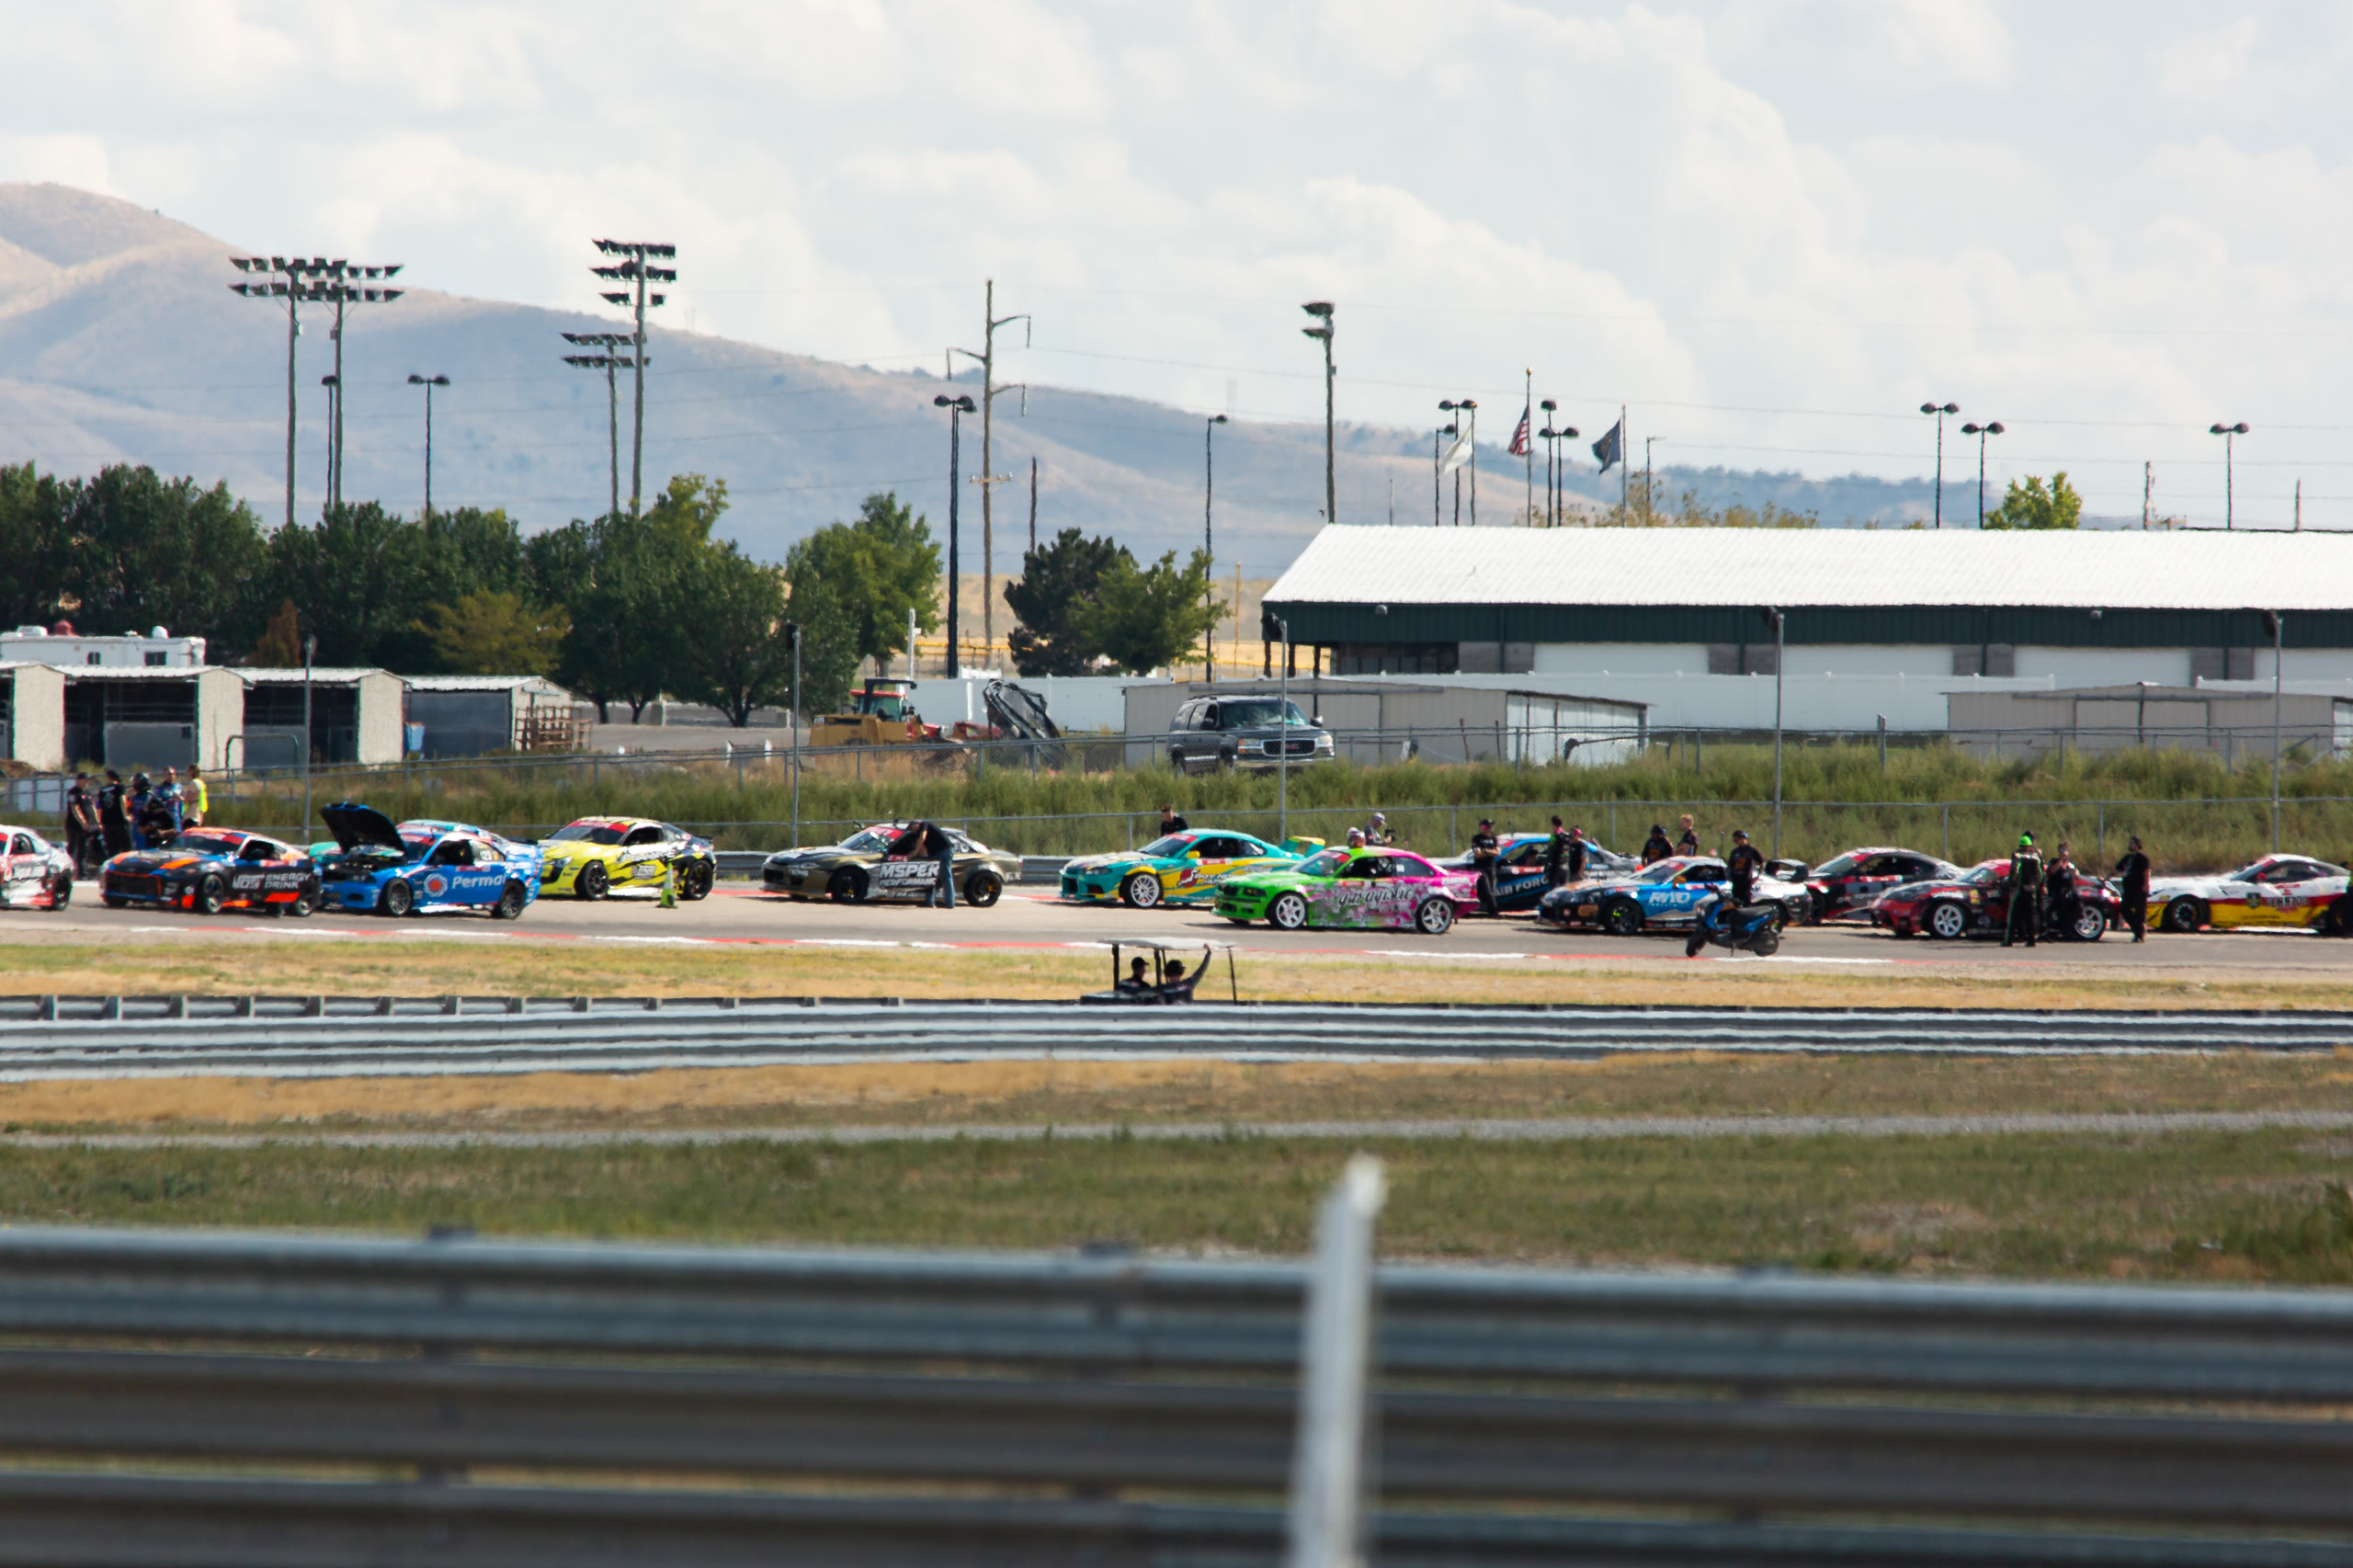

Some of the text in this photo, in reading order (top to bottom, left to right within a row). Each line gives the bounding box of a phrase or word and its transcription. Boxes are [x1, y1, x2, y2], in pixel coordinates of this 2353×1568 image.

[266, 872, 311, 882] ENERGY
[879, 877, 937, 887] PERFORMANC
[264, 880, 300, 890] DRINK
[1515, 873, 1550, 892] FORC
